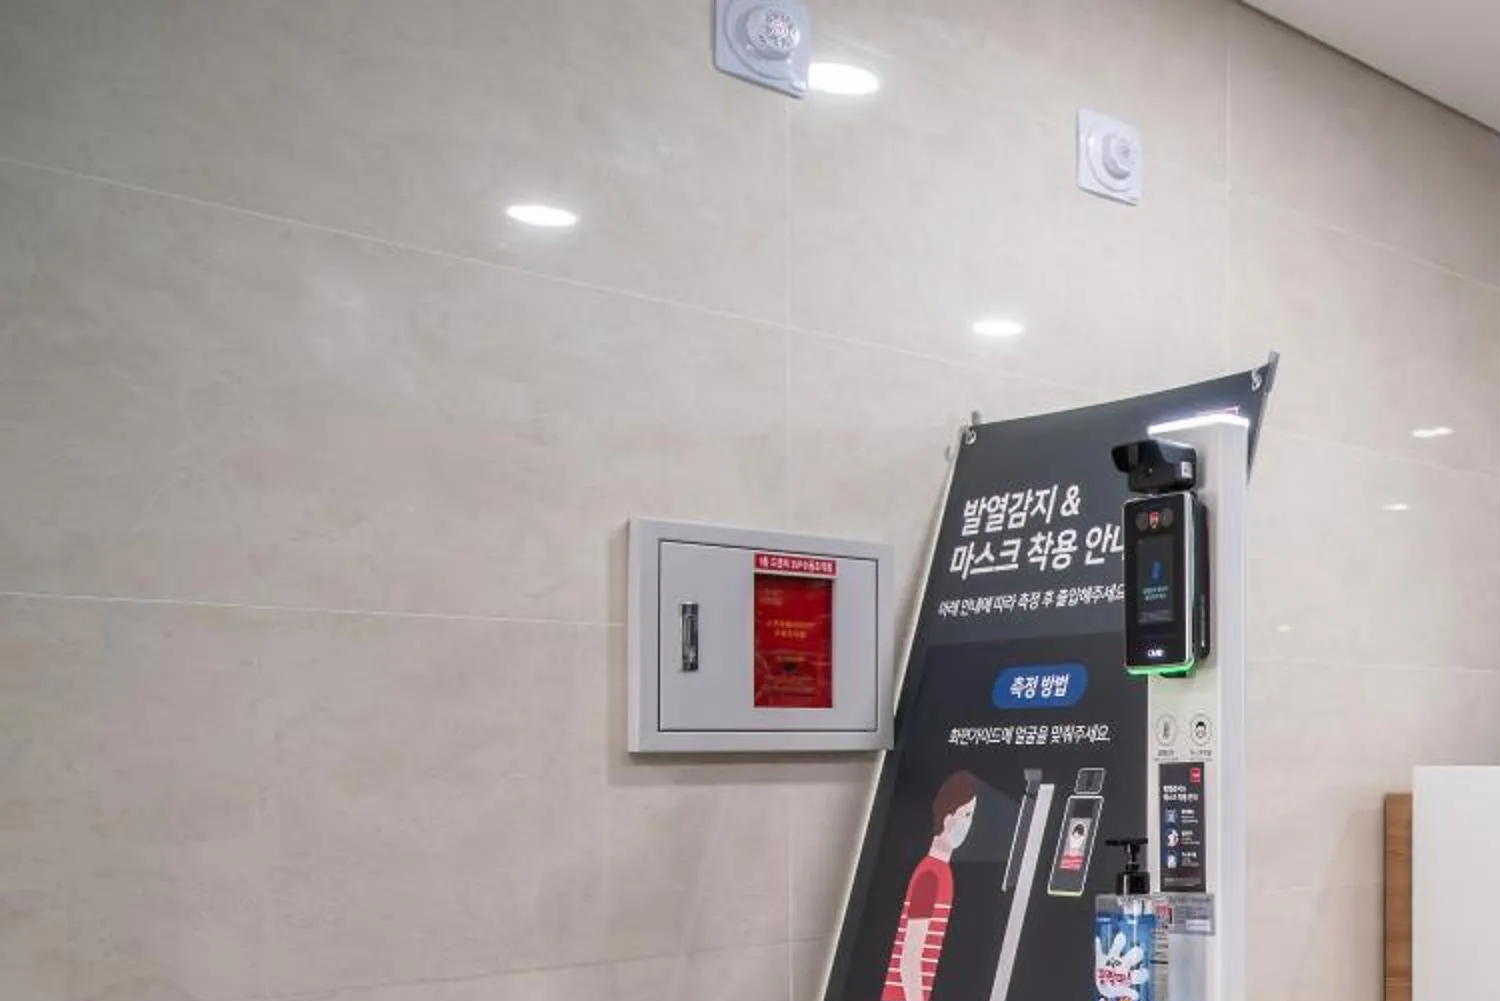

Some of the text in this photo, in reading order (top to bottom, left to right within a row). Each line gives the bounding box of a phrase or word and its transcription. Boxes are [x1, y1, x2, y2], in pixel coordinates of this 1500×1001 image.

[961, 484, 1081, 537] 발열감지 &
[950, 537, 1021, 580] 마스크
[1027, 528, 1078, 571] 착용
[1018, 591, 1041, 610] 측정
[1043, 590, 1055, 608] 후
[1010, 673, 1070, 699] 측정 방법
[1015, 725, 1049, 745] 얼굴을
